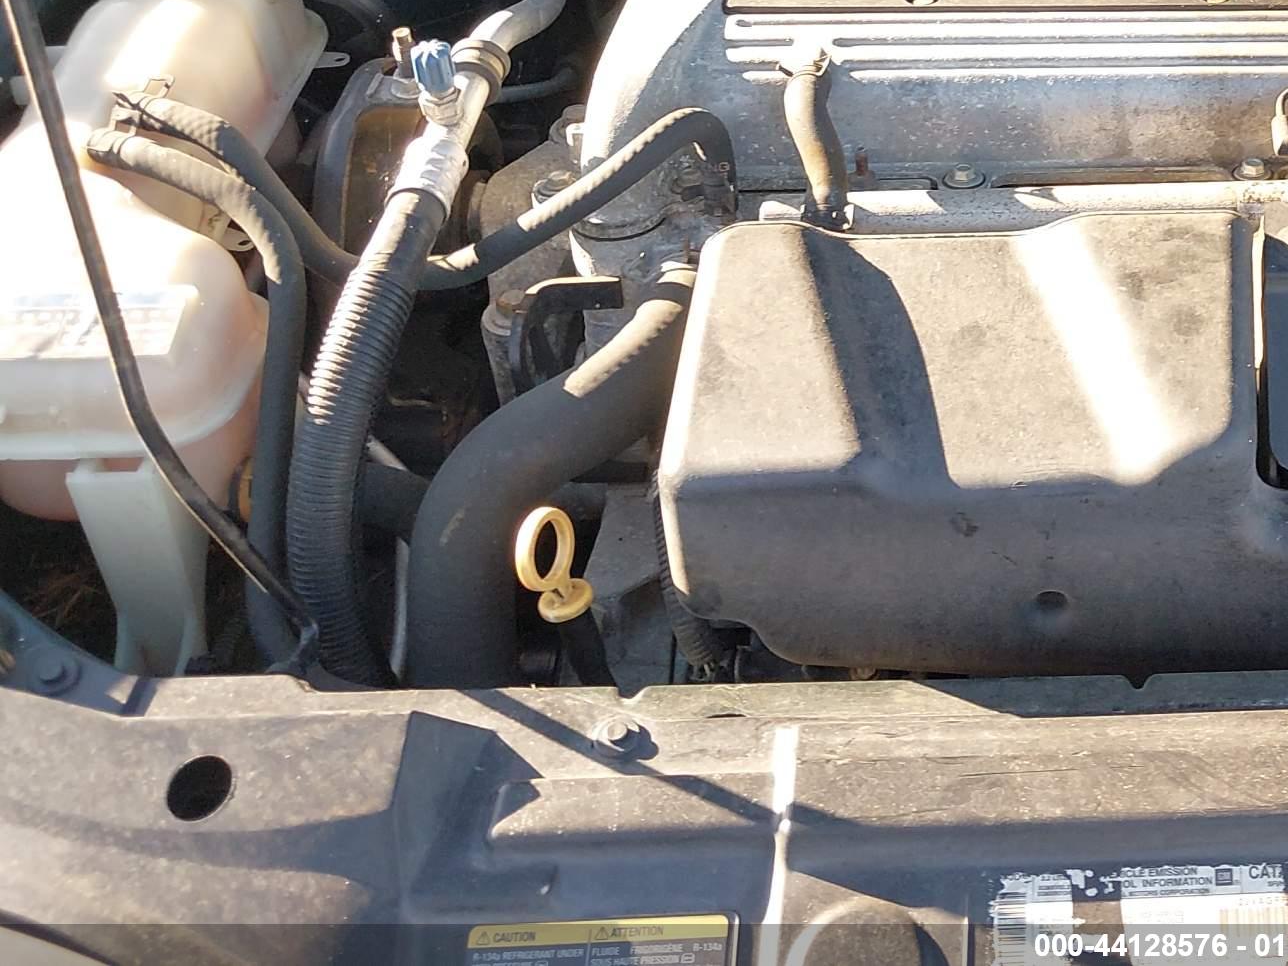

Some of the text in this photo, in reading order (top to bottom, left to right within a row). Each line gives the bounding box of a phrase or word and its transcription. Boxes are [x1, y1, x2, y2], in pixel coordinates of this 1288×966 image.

[1141, 877, 1213, 888] INFORMATION
[493, 931, 536, 943] CAUTION
[610, 926, 664, 937] ATTENTION
